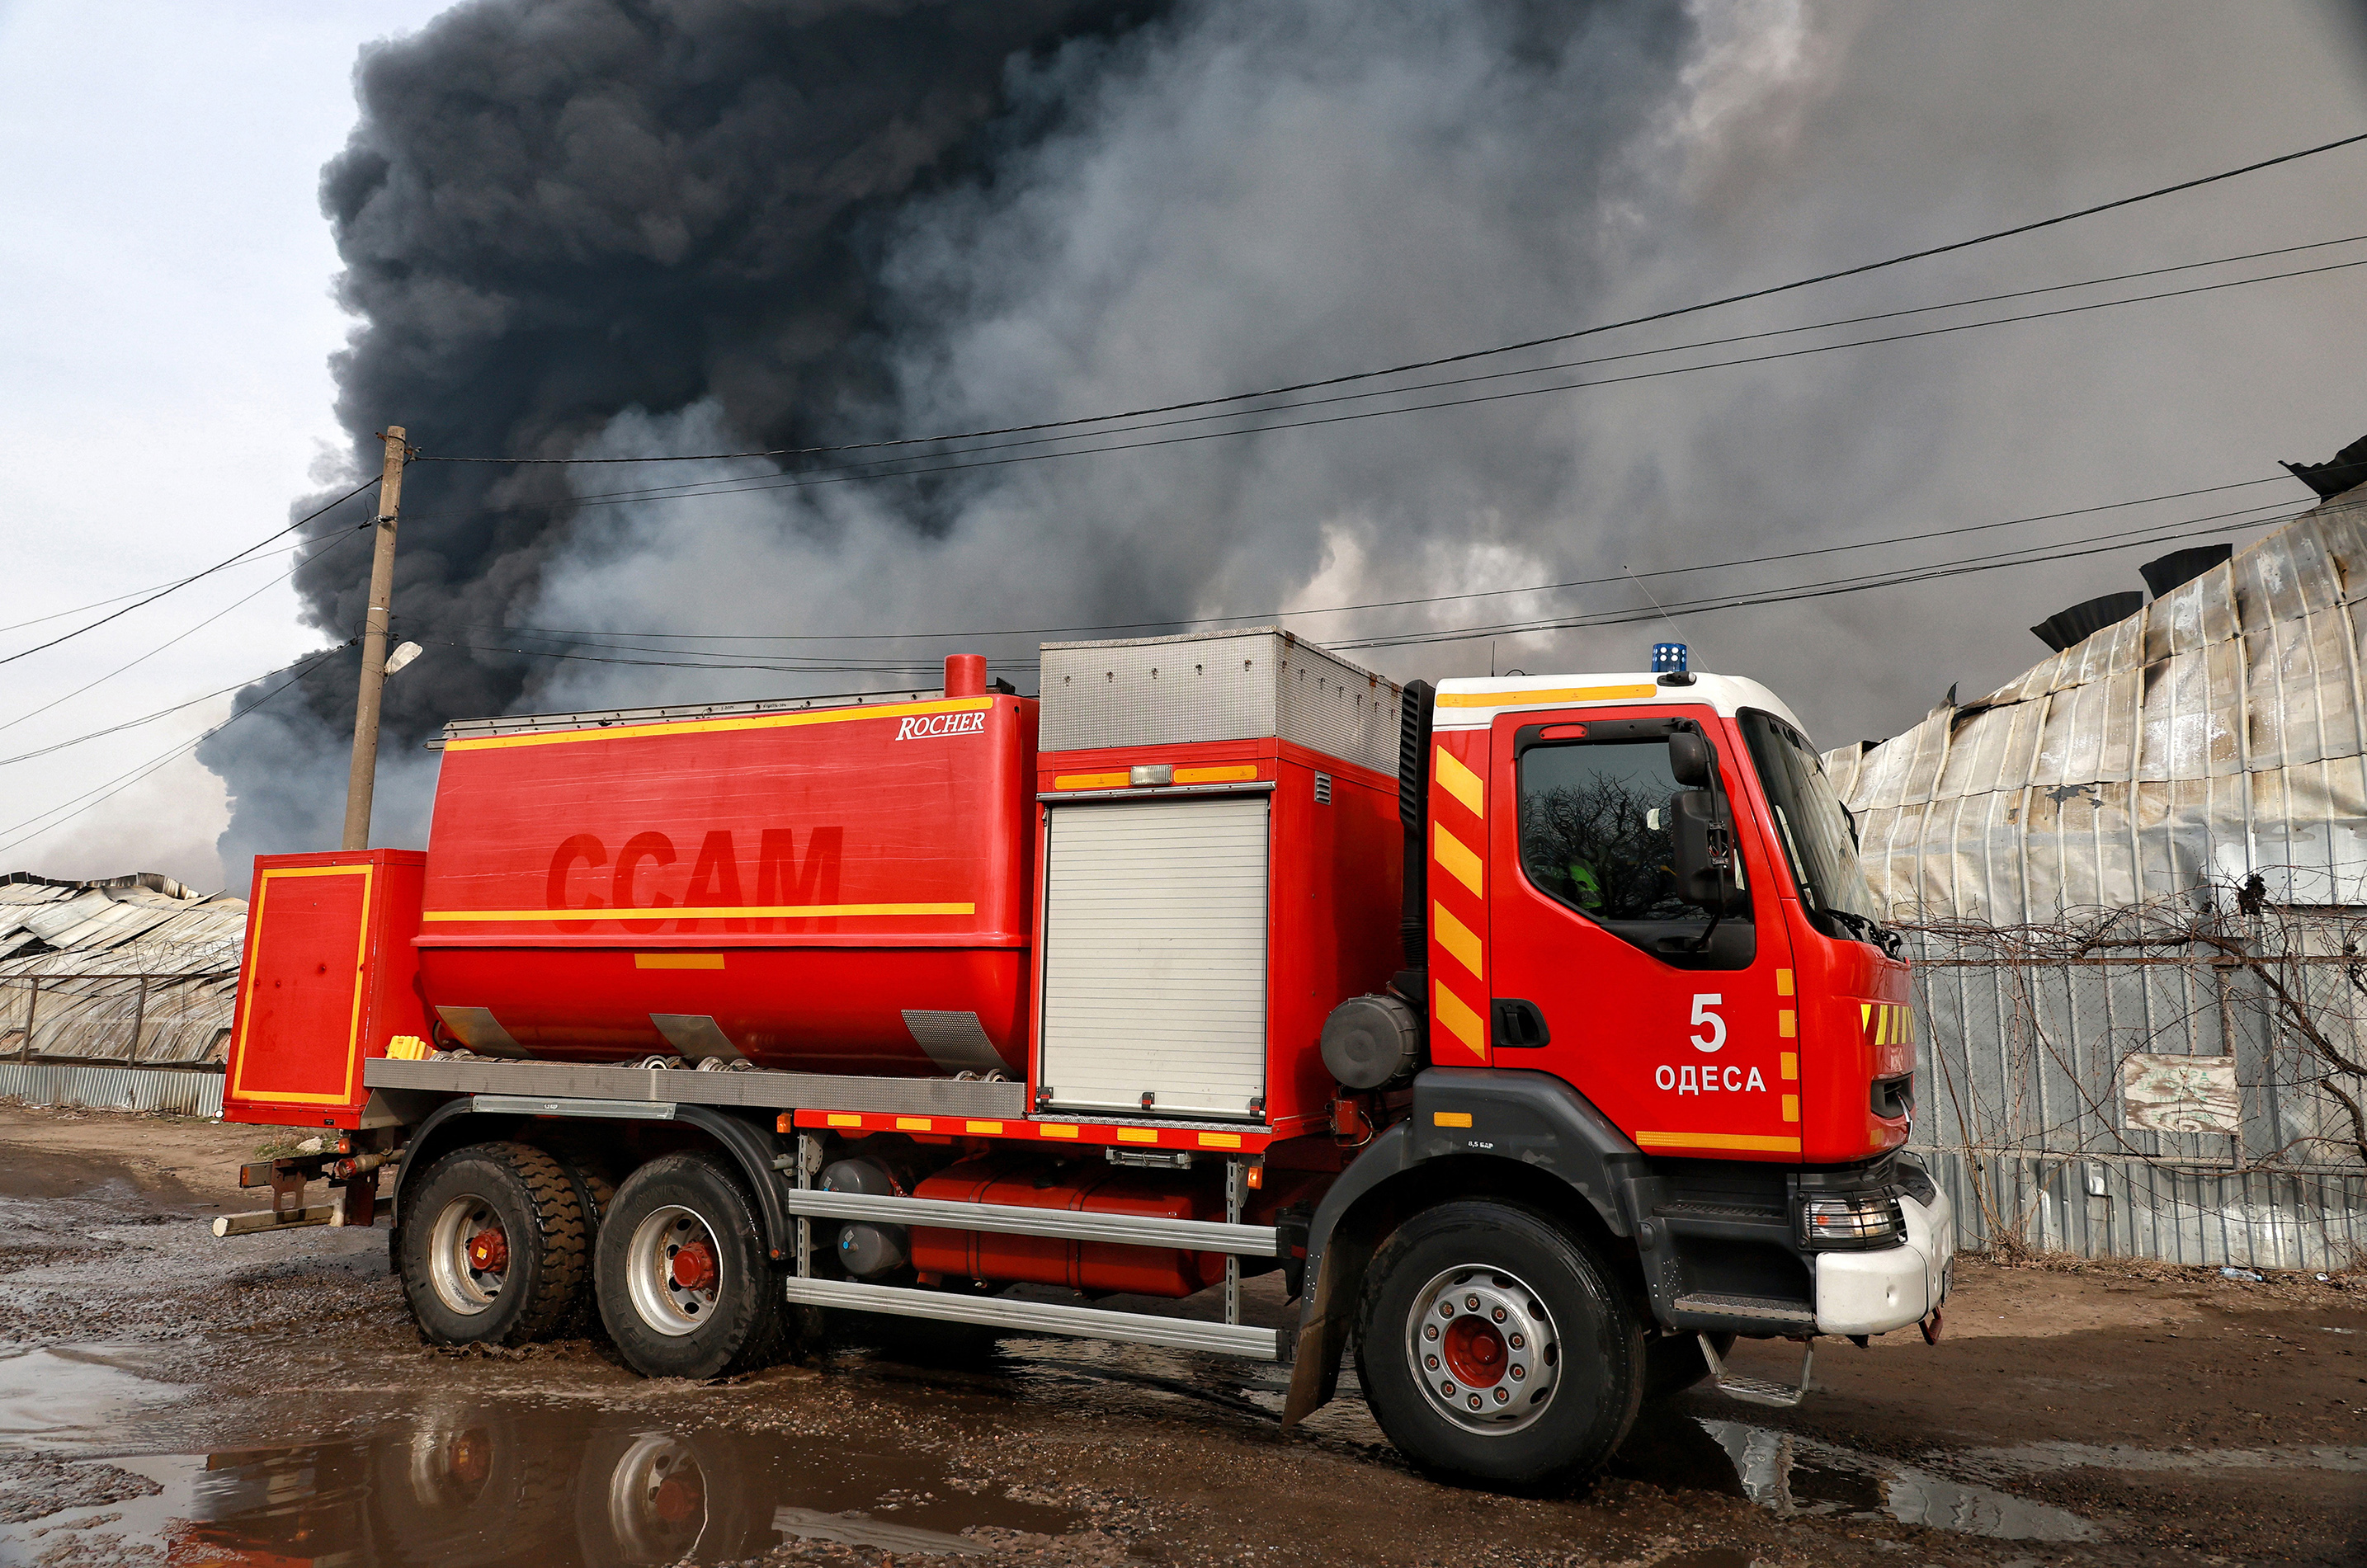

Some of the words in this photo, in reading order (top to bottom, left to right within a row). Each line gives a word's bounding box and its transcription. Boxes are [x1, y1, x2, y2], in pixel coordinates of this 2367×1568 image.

[895, 712, 985, 741] ROCHER
[545, 826, 843, 934] CCAM
[1690, 993, 1727, 1052] 5
[1655, 1065, 1766, 1095] ОДЕСА
